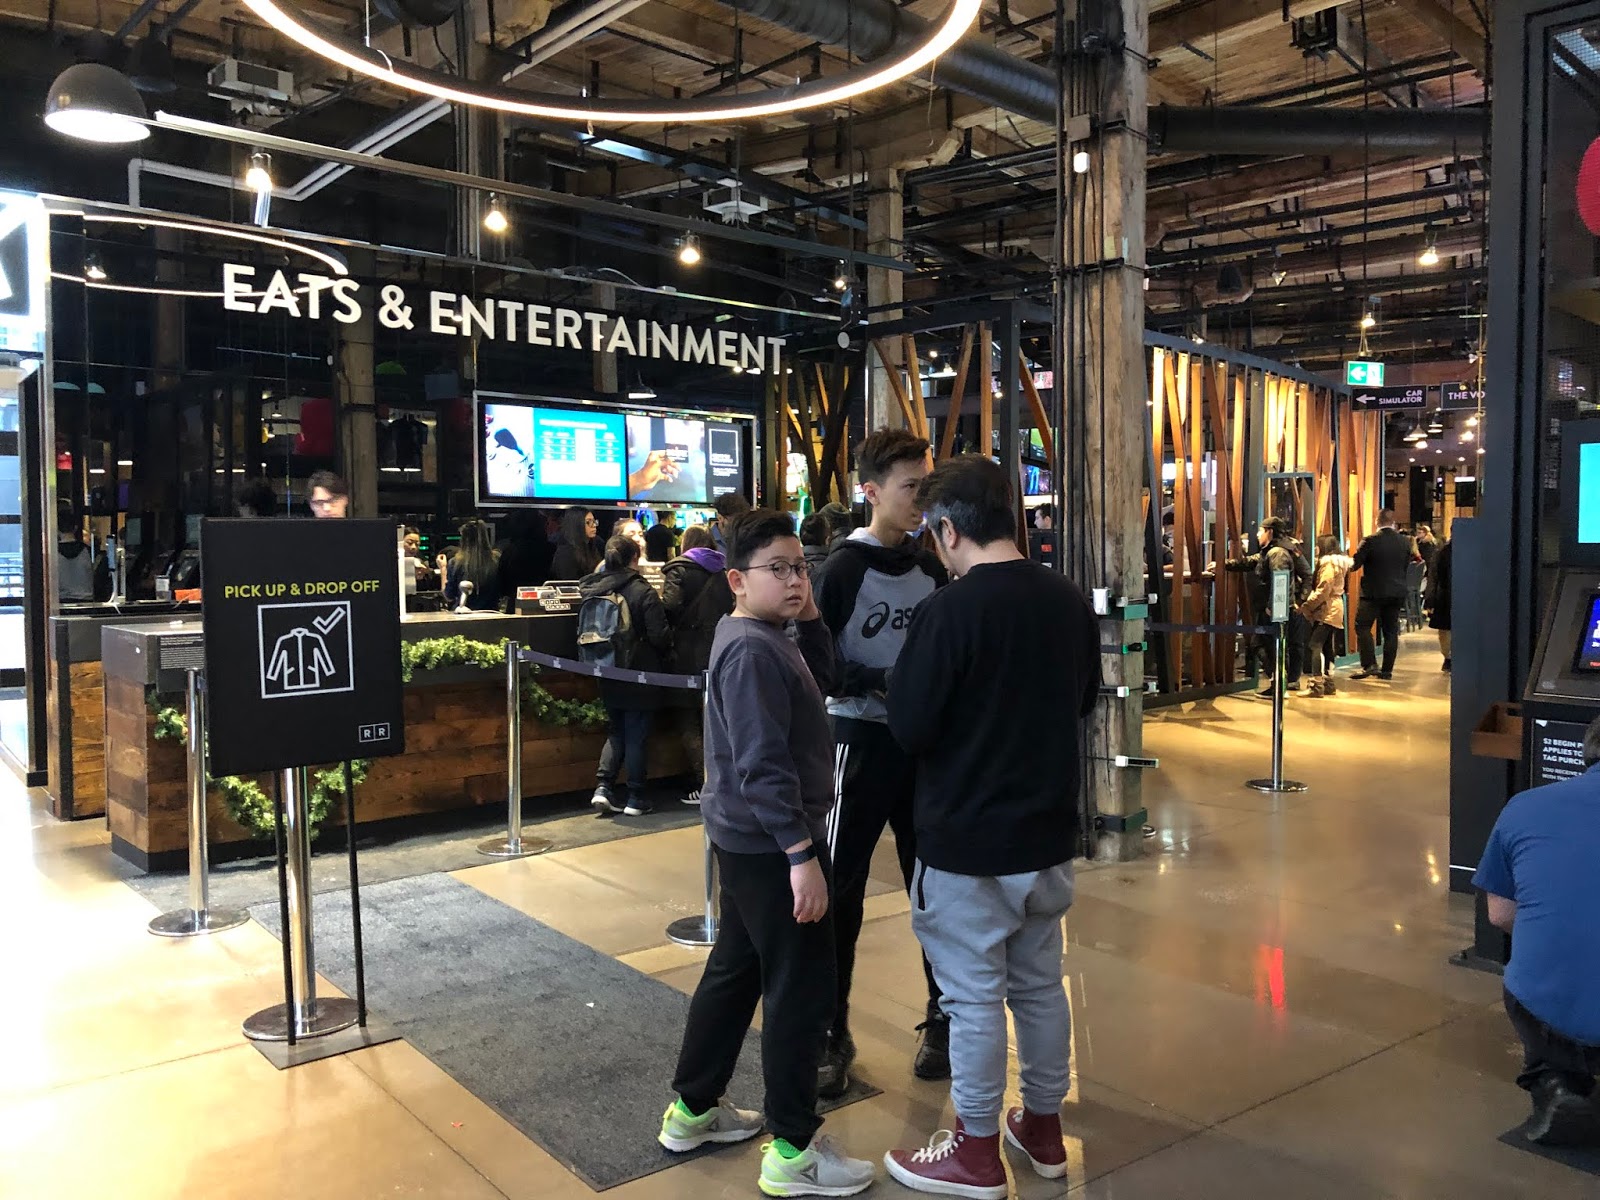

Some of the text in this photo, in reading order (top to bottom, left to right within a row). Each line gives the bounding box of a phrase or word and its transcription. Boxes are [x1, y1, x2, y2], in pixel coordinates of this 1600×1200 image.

[223, 262, 787, 375] EATS & ENTERTAINMENT
[1405, 389, 1423, 397] CAR
[1447, 390, 1486, 400] THE VO
[1378, 396, 1423, 405] SIMULATOR
[224, 580, 380, 598] PICK UP & DROP OFF
[891, 607, 913, 630] as
[1553, 739, 1576, 747] BEGIN
[1543, 747, 1573, 755] APPLIES
[1558, 756, 1585, 765] PURCH
